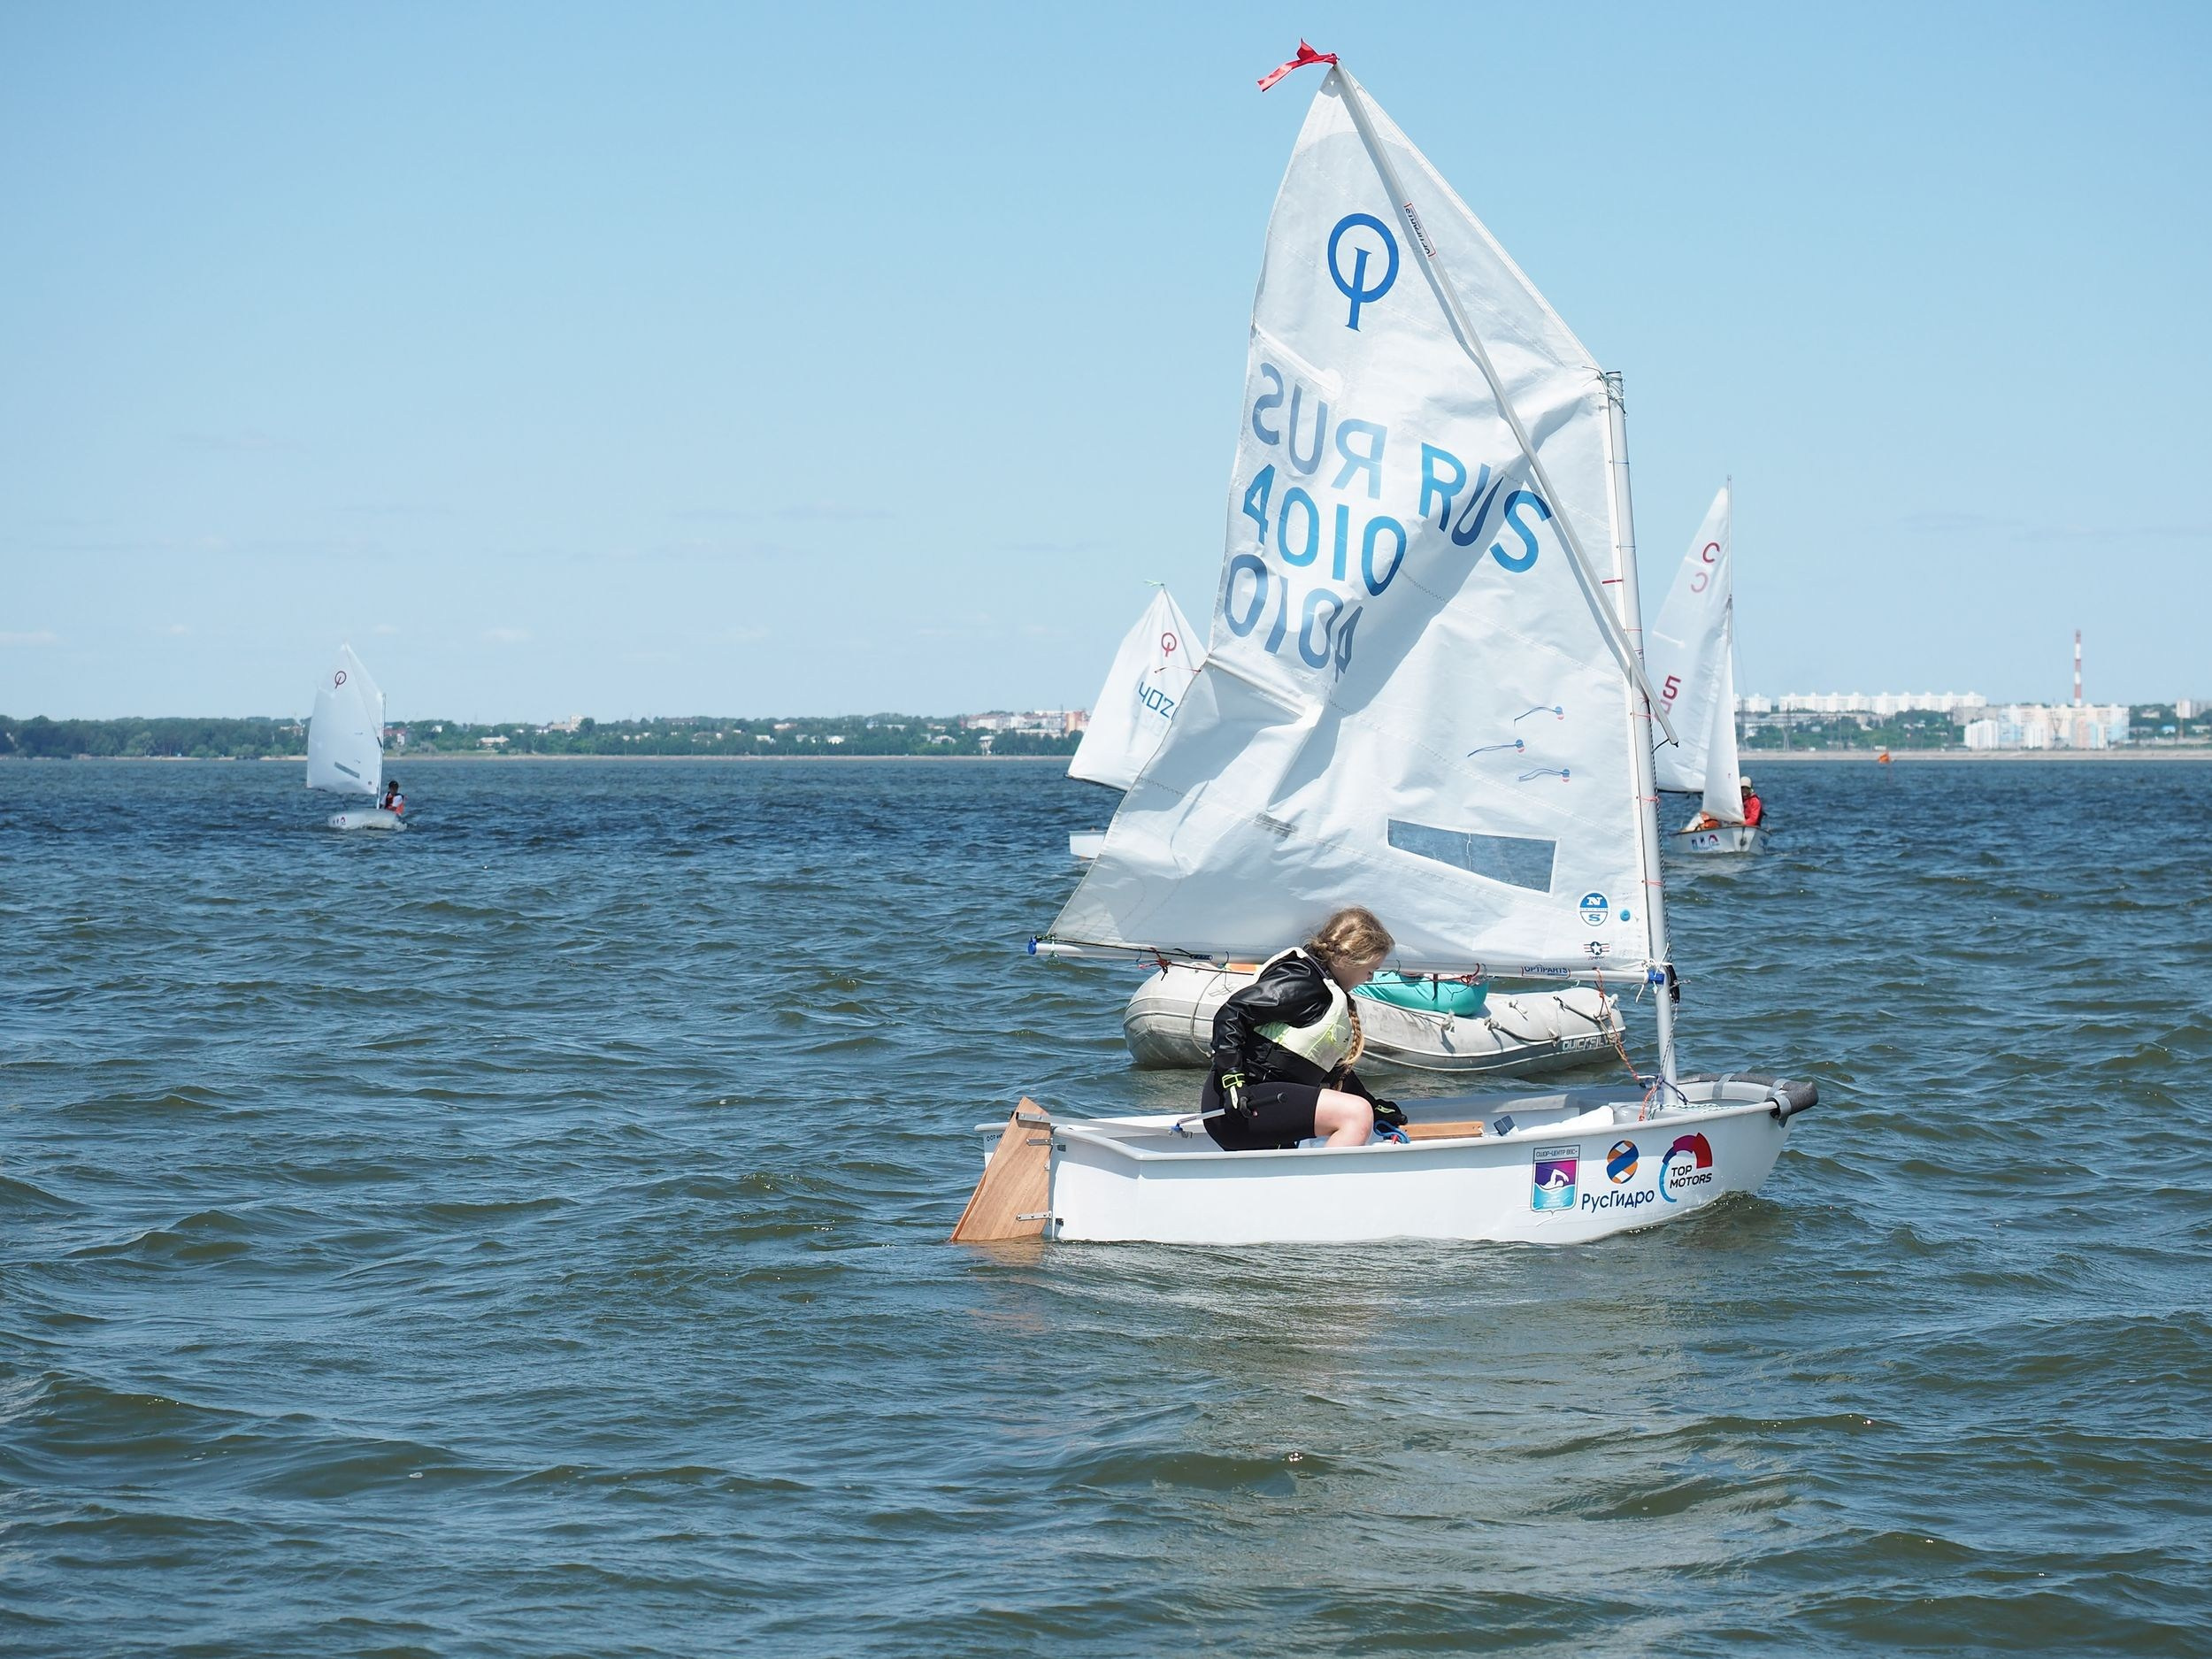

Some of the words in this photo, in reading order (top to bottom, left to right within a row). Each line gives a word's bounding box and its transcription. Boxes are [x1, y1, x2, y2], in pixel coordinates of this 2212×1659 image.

[1418, 442, 1552, 573] RUS
[1242, 464, 1407, 596] 4010
[1663, 675, 1682, 700] 5
[1138, 681, 1179, 721] 402
[1586, 896, 1602, 906] N
[1670, 1172, 1713, 1188] MOTORS
[1671, 1164, 1693, 1177] TOP
[1581, 1190, 1655, 1213] РусГидро
